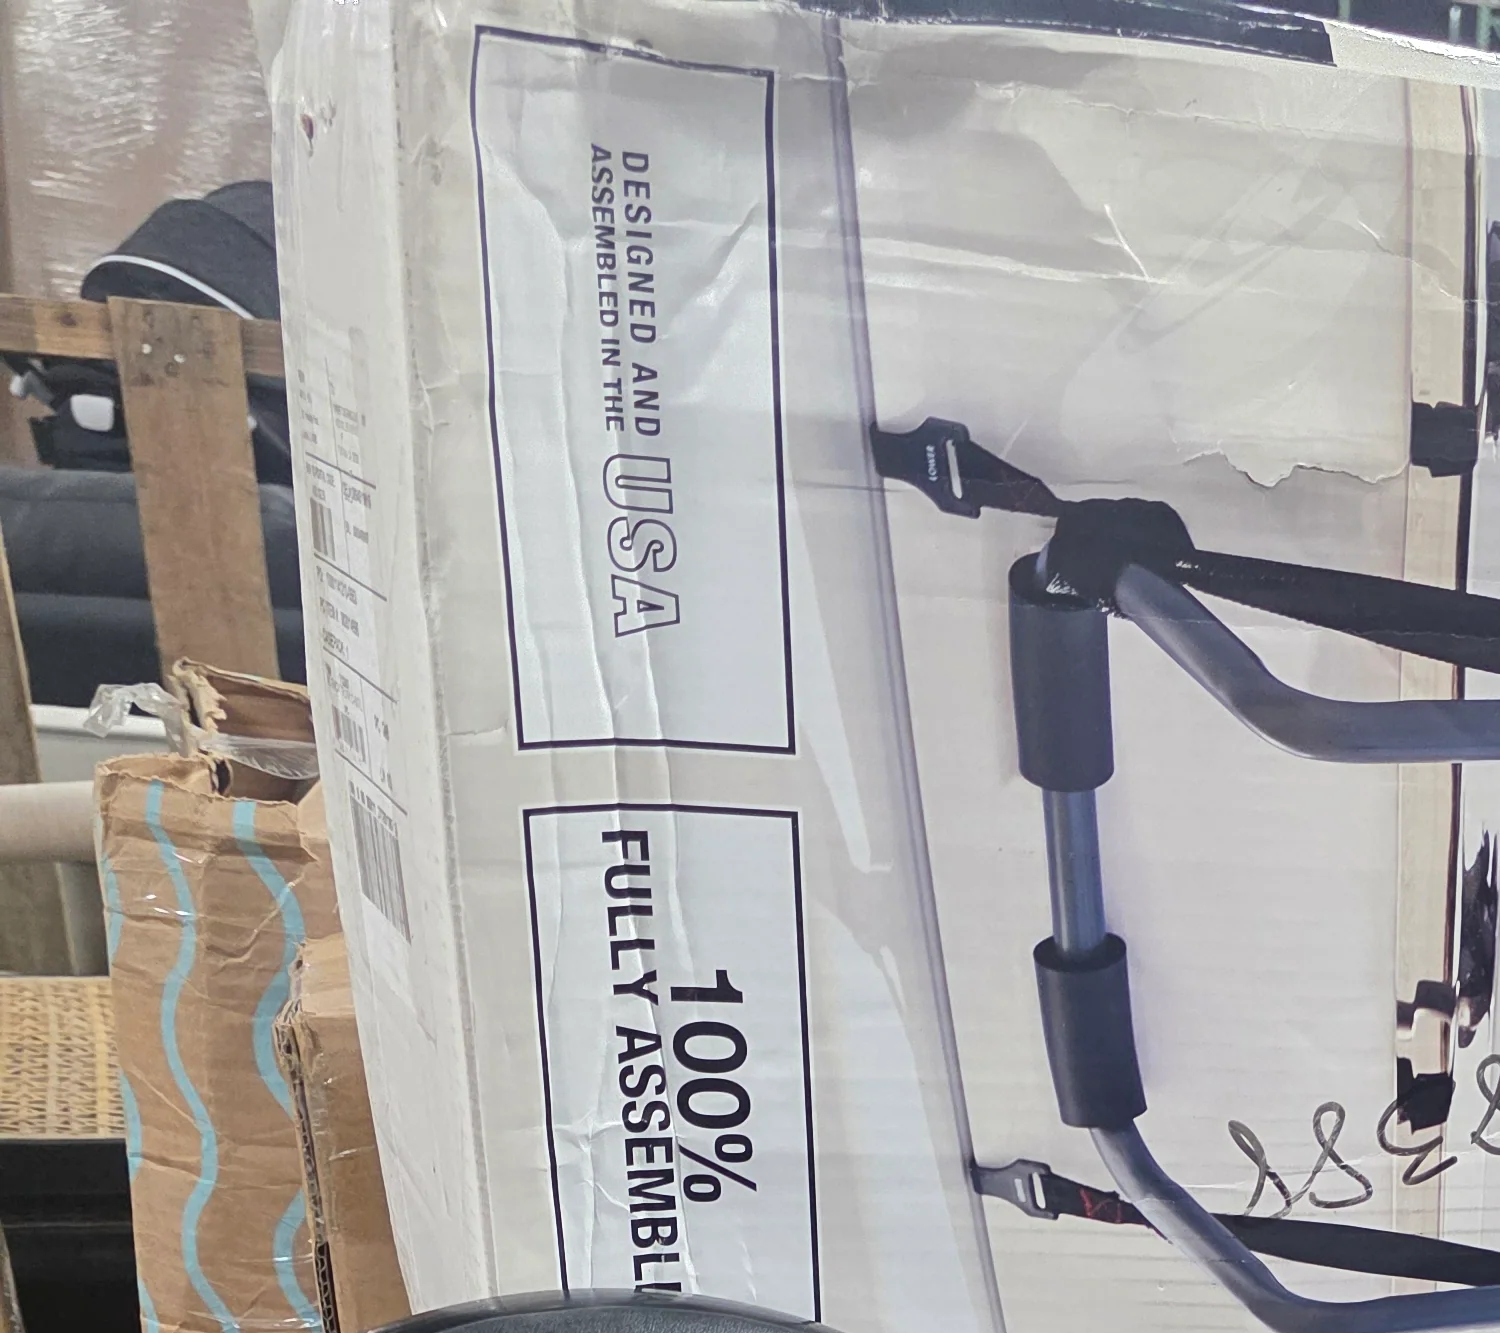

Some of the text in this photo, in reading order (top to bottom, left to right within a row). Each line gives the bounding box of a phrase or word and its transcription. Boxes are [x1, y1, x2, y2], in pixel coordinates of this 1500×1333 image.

[590, 143, 625, 432] ASSEMBLED IN THE
[622, 151, 661, 437] DESIGNED AND
[602, 453, 681, 638] USA
[600, 829, 659, 1006] FULLY
[670, 968, 757, 1203] 100%
